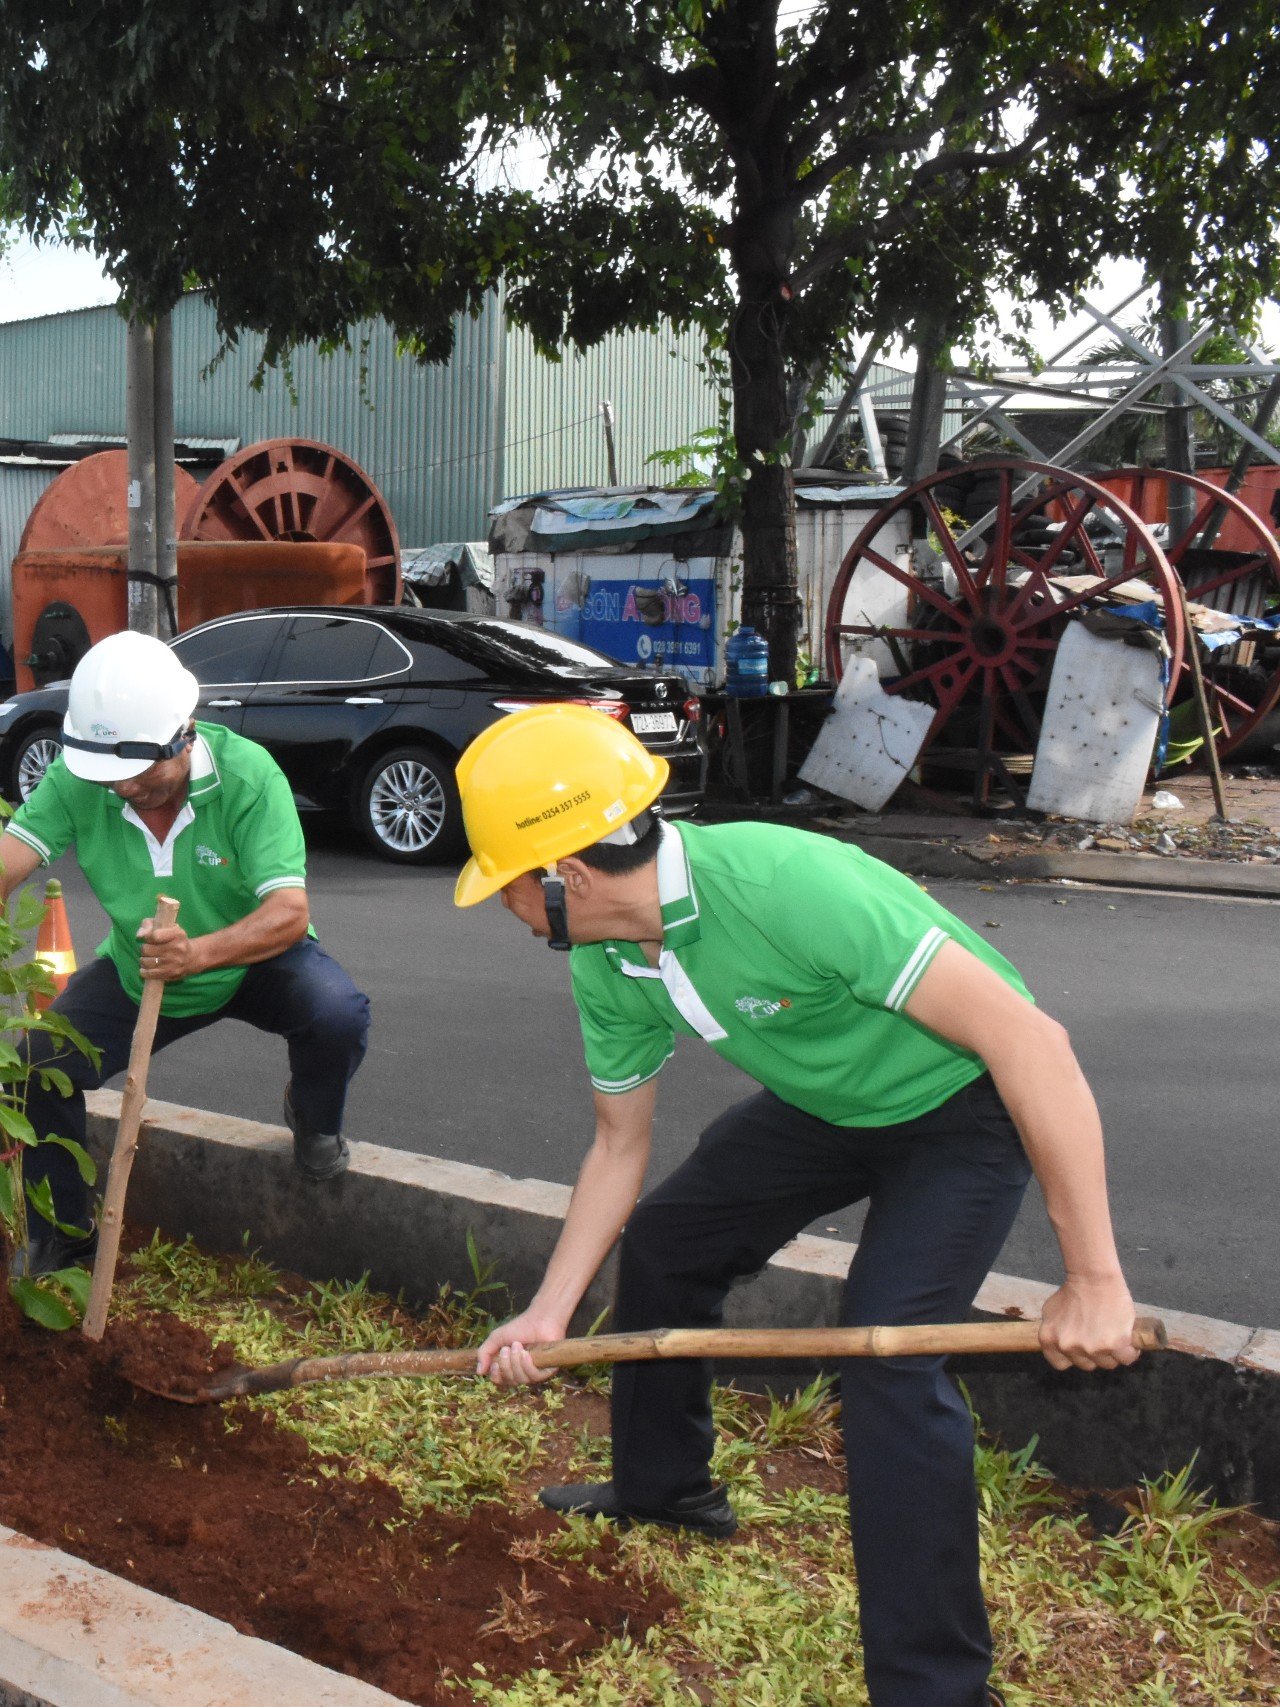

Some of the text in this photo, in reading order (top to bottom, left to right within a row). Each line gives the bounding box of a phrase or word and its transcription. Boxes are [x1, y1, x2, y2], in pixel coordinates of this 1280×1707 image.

[515, 790, 591, 829] hotline: 0254 357 5555
